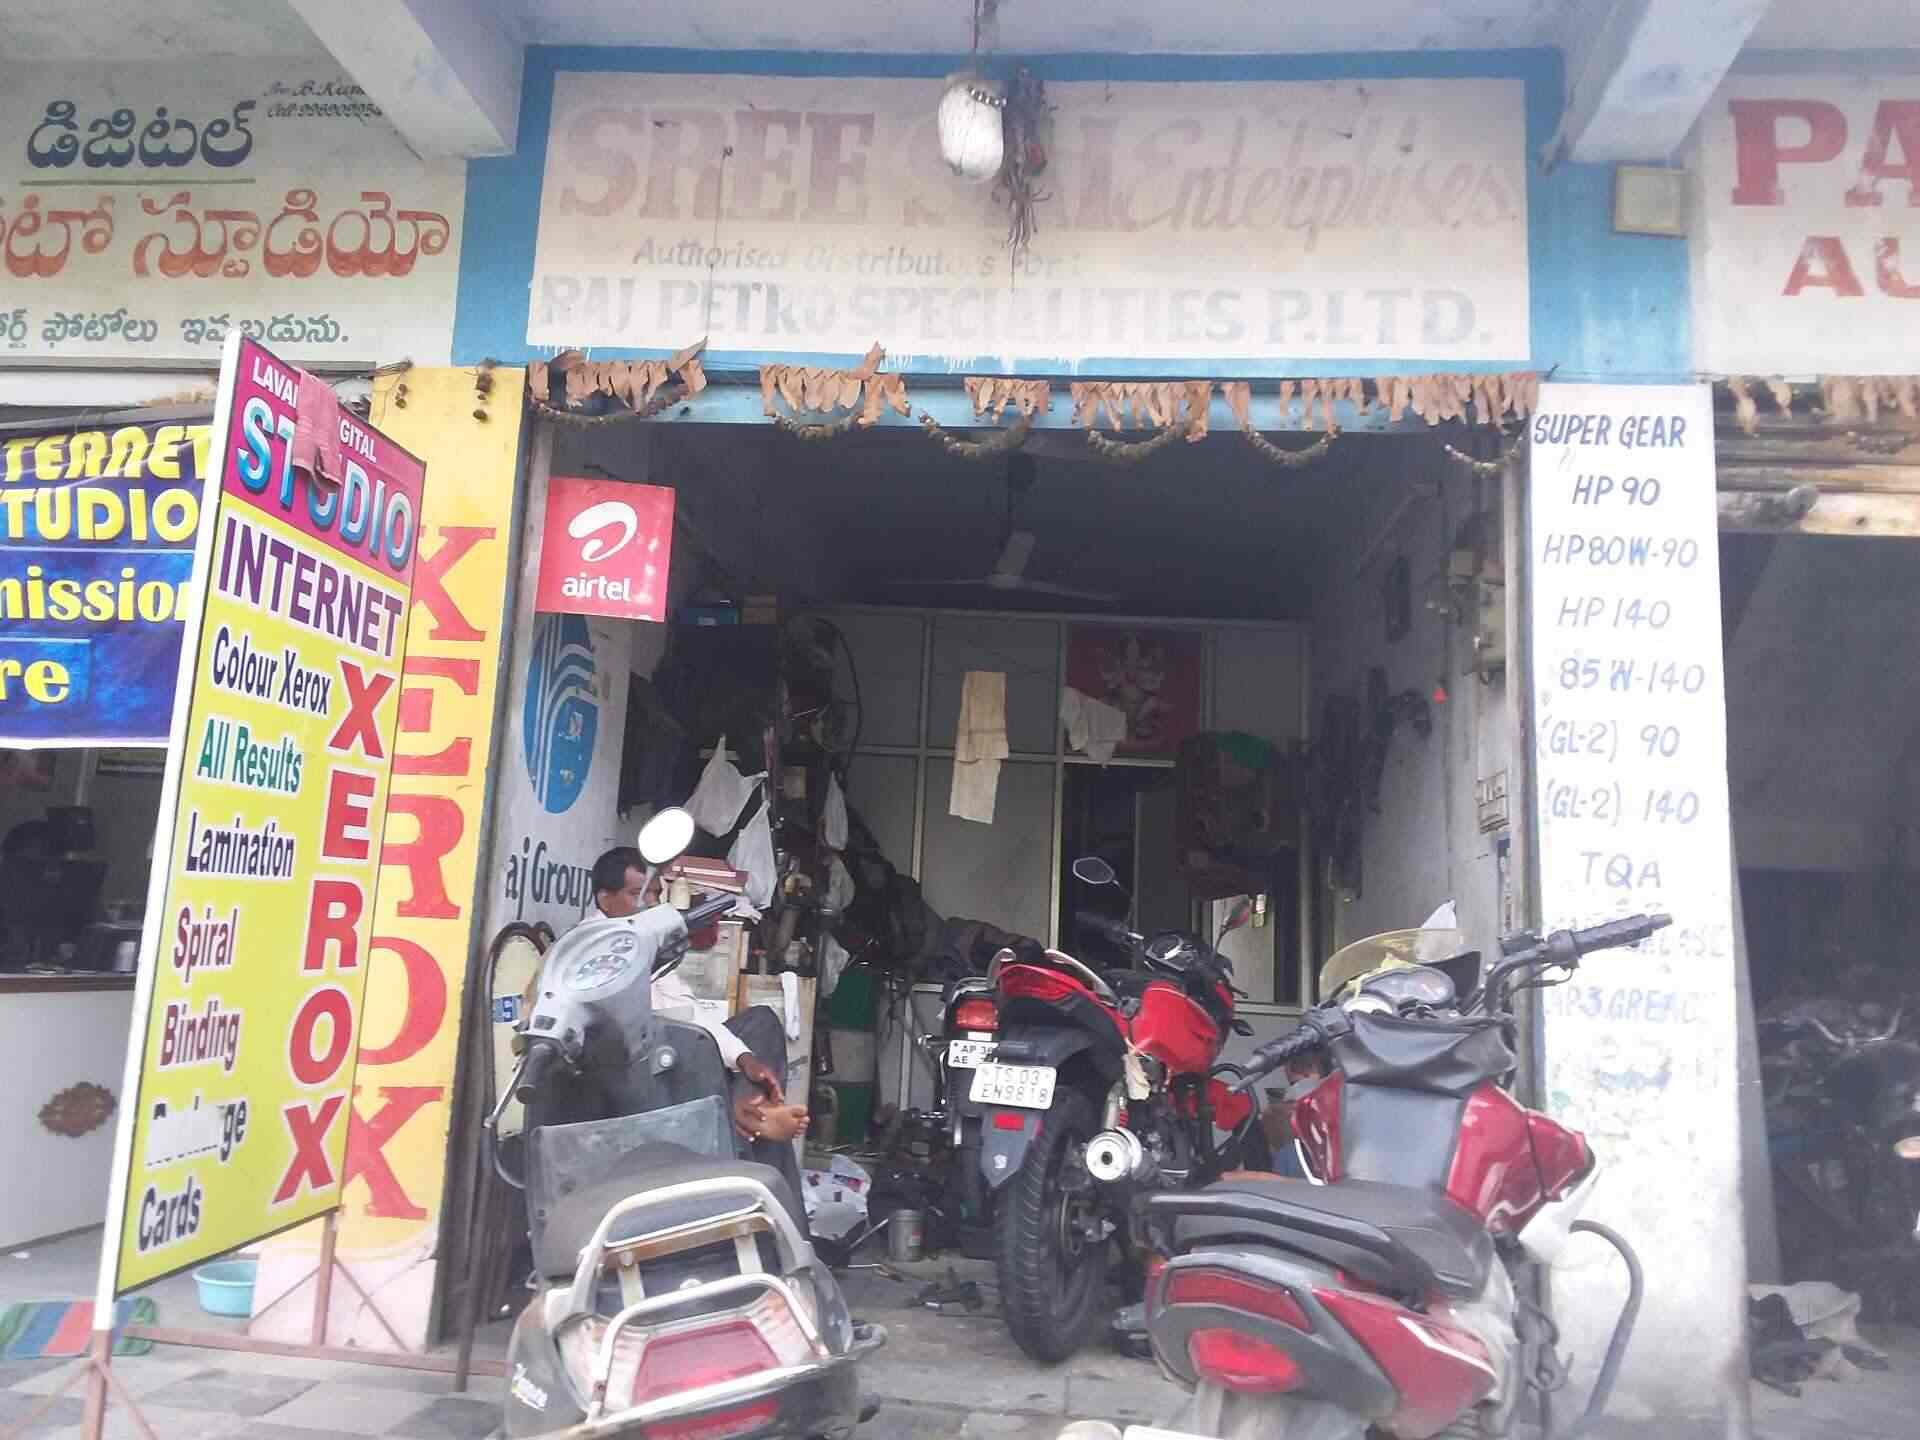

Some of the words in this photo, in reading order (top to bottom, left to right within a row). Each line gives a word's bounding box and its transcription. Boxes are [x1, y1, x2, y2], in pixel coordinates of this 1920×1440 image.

[27, 100, 256, 168] డిజిటల్
[558, 106, 876, 221] SREE
[0, 193, 115, 278] టో
[133, 188, 450, 278] స్టూడియో
[633, 236, 790, 270] Authorised
[537, 275, 637, 334] RAJ
[337, 415, 377, 464] GITAL
[1534, 414, 1611, 445] SUPER
[1619, 415, 1686, 449] GEAR
[0, 487, 200, 543] TUDIO
[218, 517, 402, 657] INTERNET
[562, 572, 632, 602] airtel
[213, 626, 278, 698] Colour
[278, 649, 331, 715] Xerox
[198, 718, 230, 780] All
[232, 726, 303, 793] Results
[1639, 724, 1680, 757] 90
[1643, 788, 1701, 825] 140
[185, 811, 294, 879] Lamination
[532, 840, 594, 921] Group
[174, 906, 236, 983] Spiral
[272, 660, 395, 1206] XEROX
[160, 1000, 241, 1071] Binding
[139, 1175, 202, 1251] Cards
